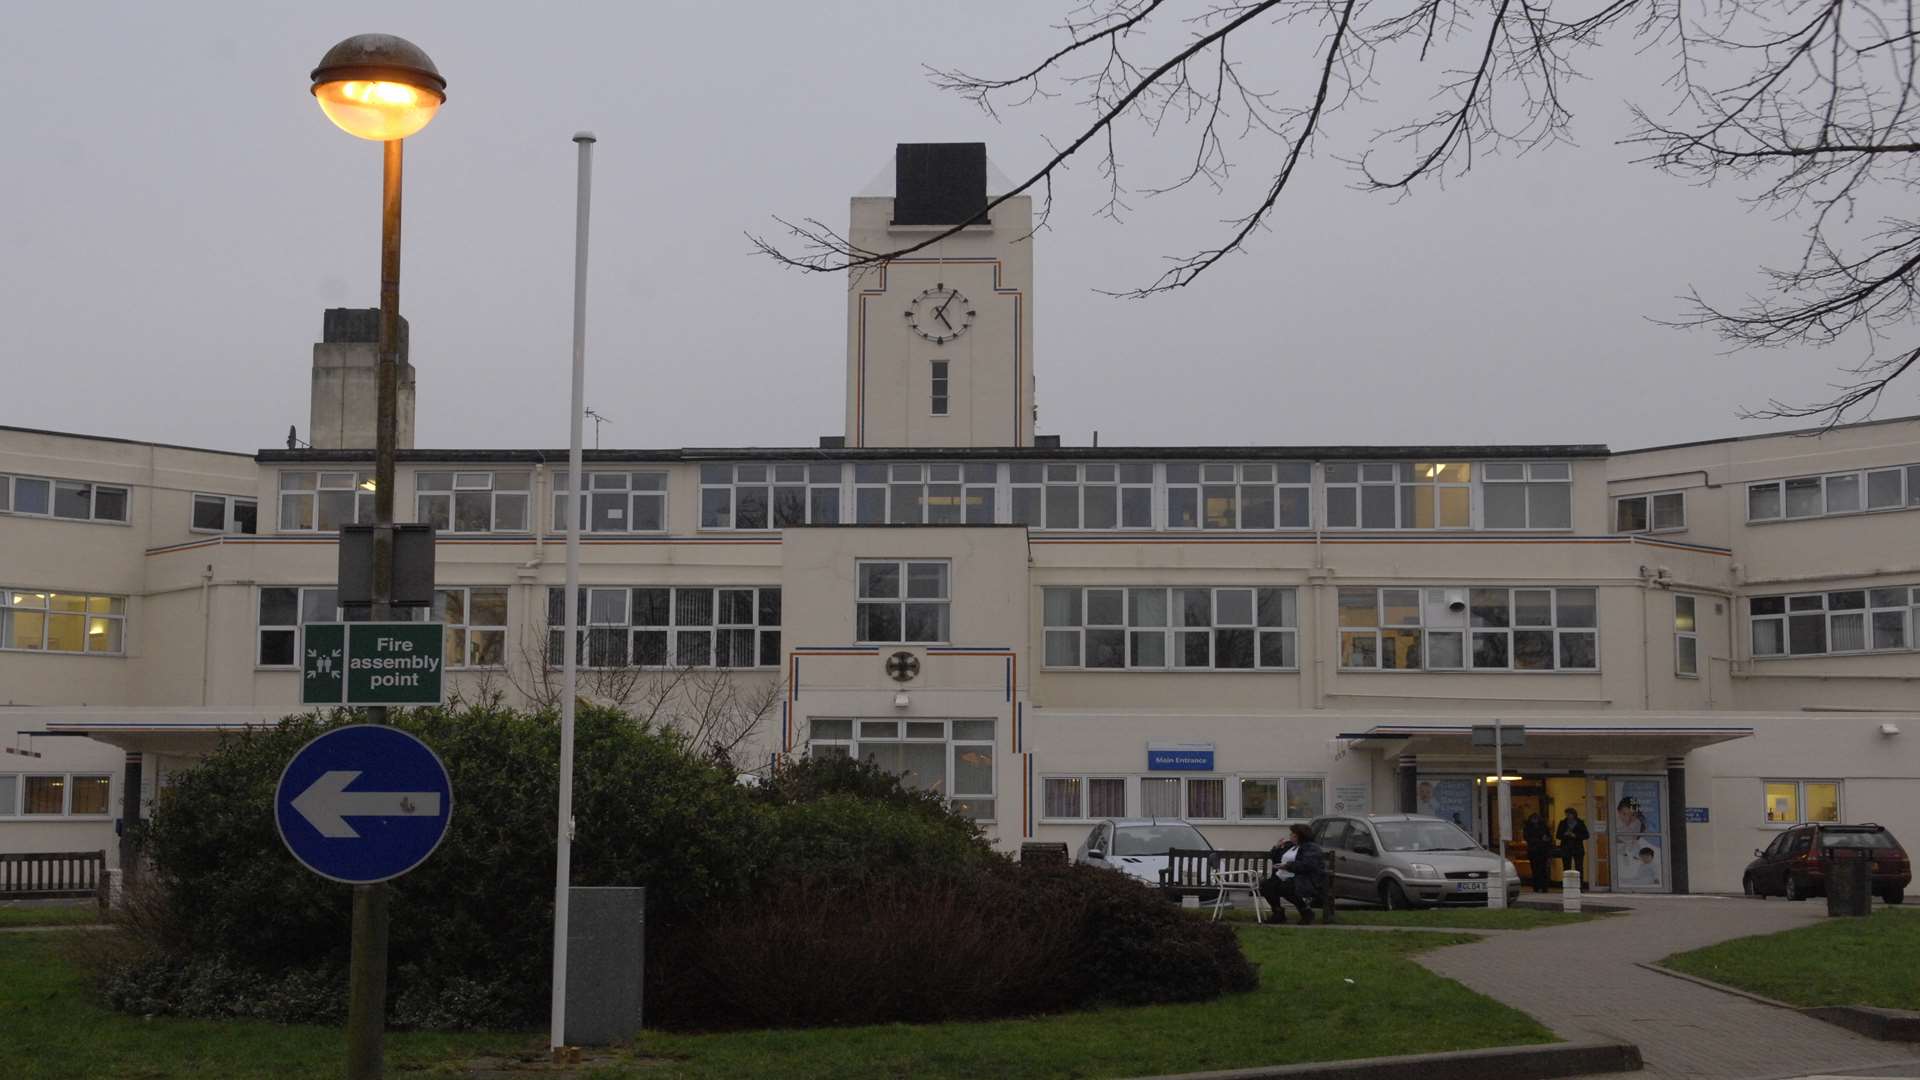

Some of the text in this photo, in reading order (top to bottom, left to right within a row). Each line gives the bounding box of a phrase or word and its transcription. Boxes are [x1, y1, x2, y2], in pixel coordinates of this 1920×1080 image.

[376, 637, 414, 652] Fire
[350, 654, 440, 672] assembly
[370, 672, 420, 690] point
[1155, 756, 1207, 764] Main Entrance
